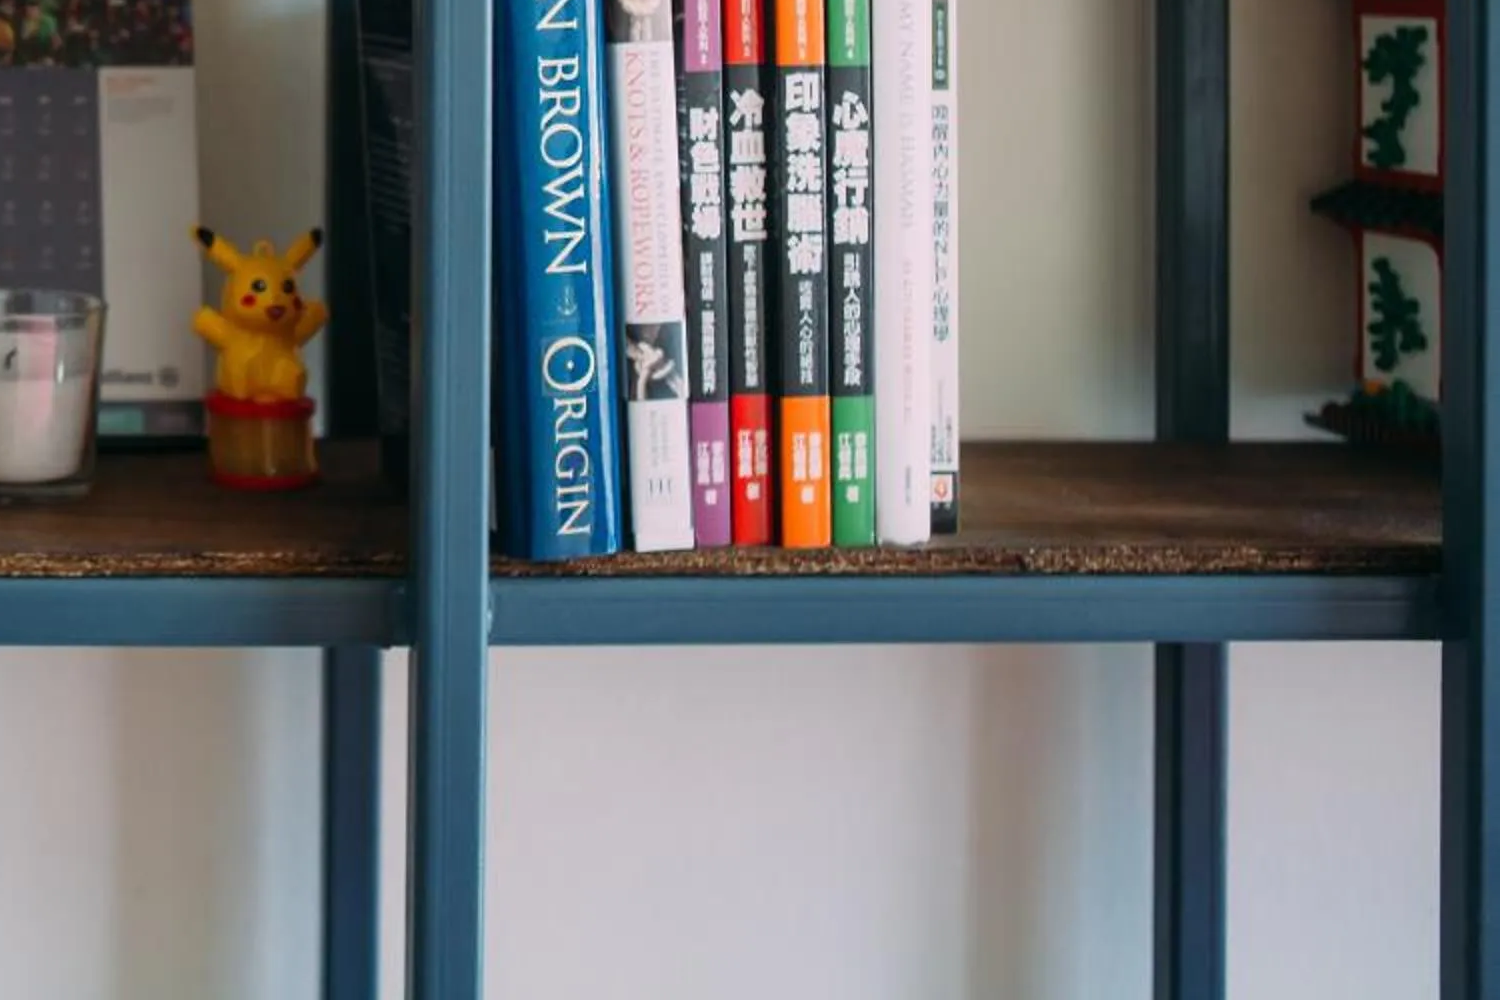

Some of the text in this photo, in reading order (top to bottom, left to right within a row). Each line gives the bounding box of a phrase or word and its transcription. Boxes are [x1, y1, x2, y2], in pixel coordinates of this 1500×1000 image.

[625, 50, 649, 141] KNOTS
[899, 41, 915, 105] NAME
[537, 54, 588, 275] BROWN
[630, 169, 655, 316] ROPEWORK
[542, 335, 596, 536] ORIGIN
